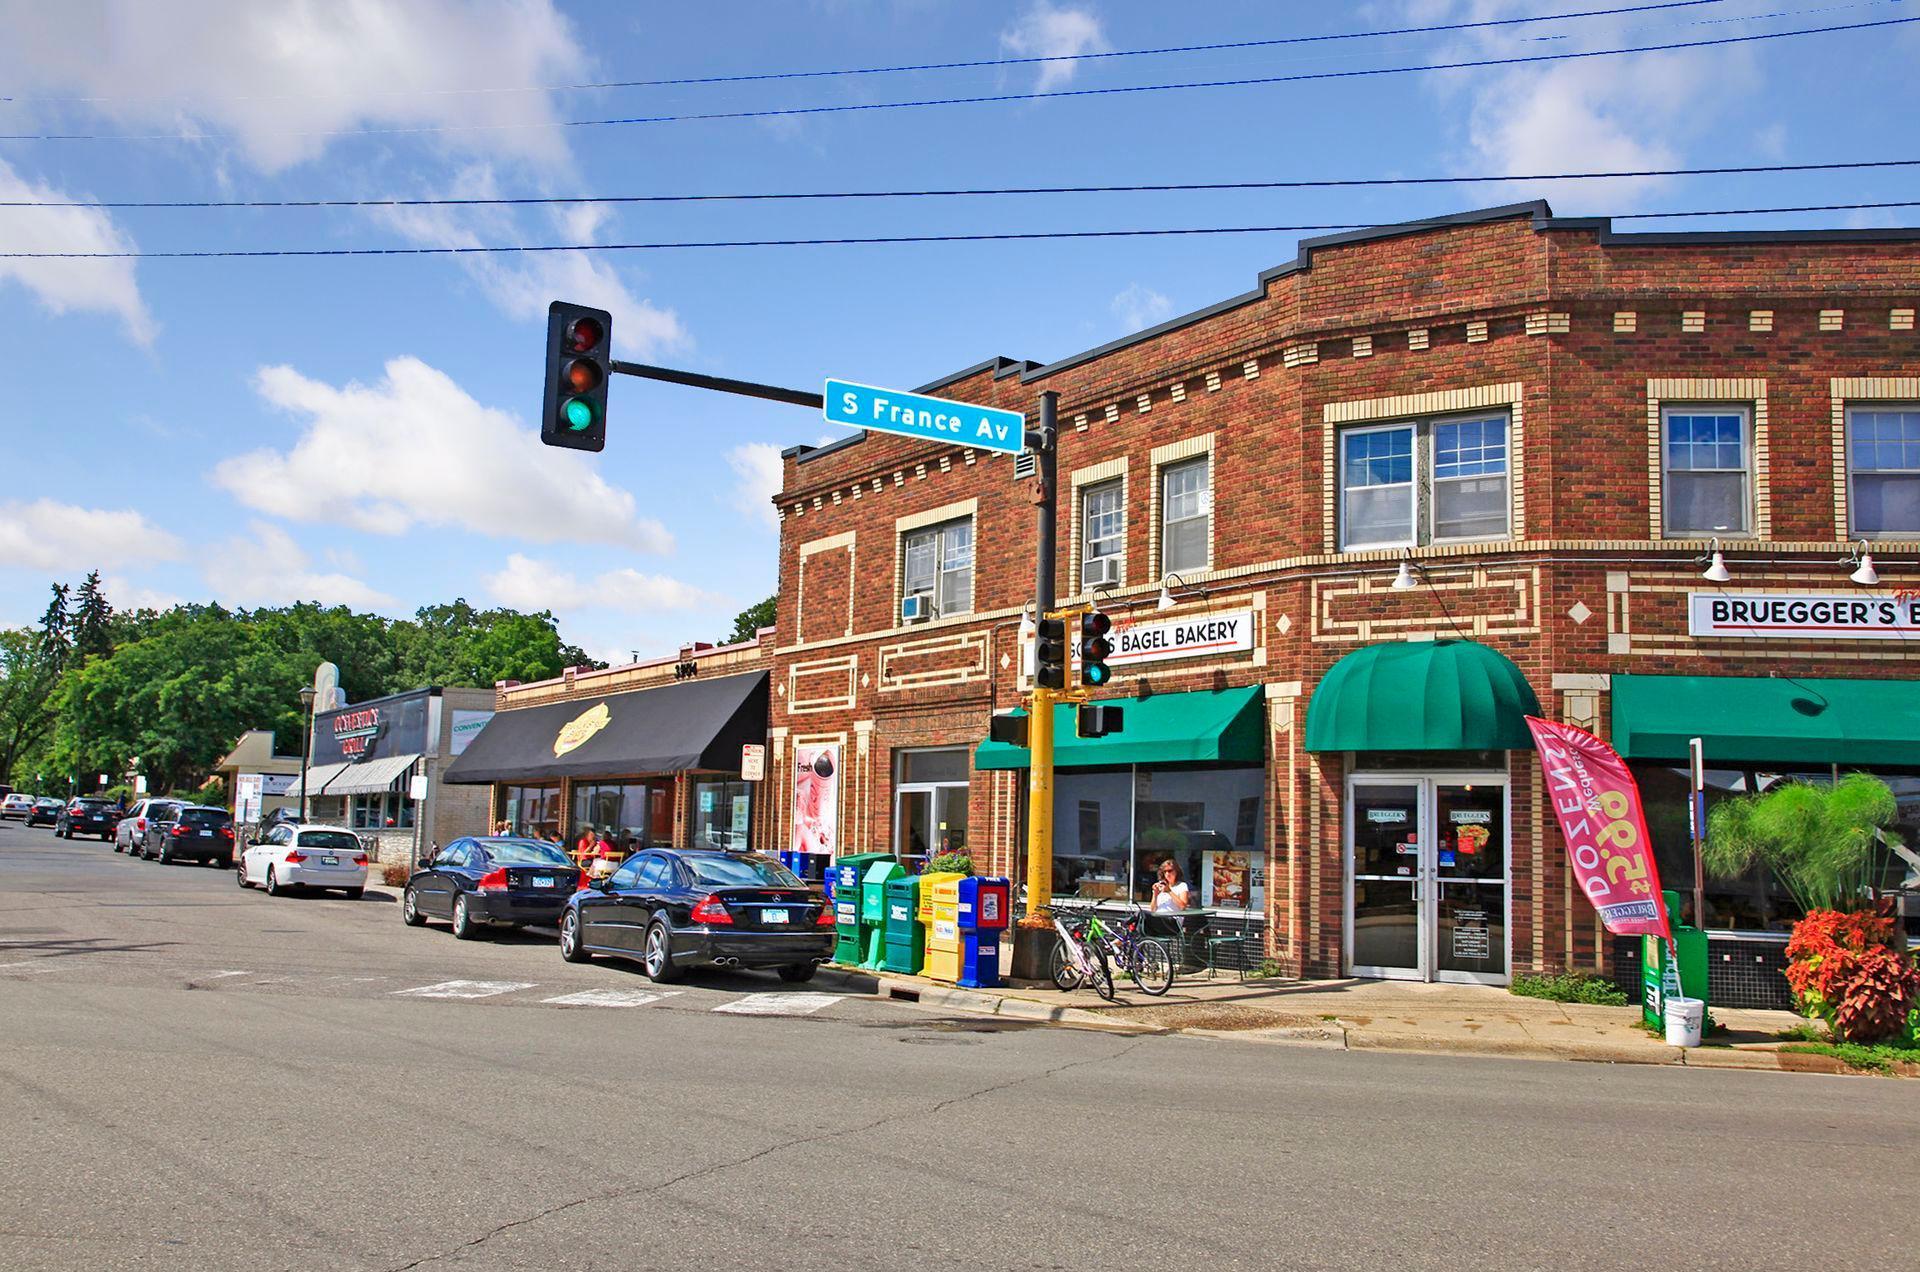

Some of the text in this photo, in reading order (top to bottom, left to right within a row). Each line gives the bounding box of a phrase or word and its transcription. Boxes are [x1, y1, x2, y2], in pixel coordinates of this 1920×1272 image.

[842, 392, 1009, 441] S France Av
[1712, 600, 1896, 625] BRUEGGER'S
[1121, 630, 1169, 653] BAGEL
[1175, 619, 1238, 646] BAKERY
[797, 762, 813, 773] Fresh
